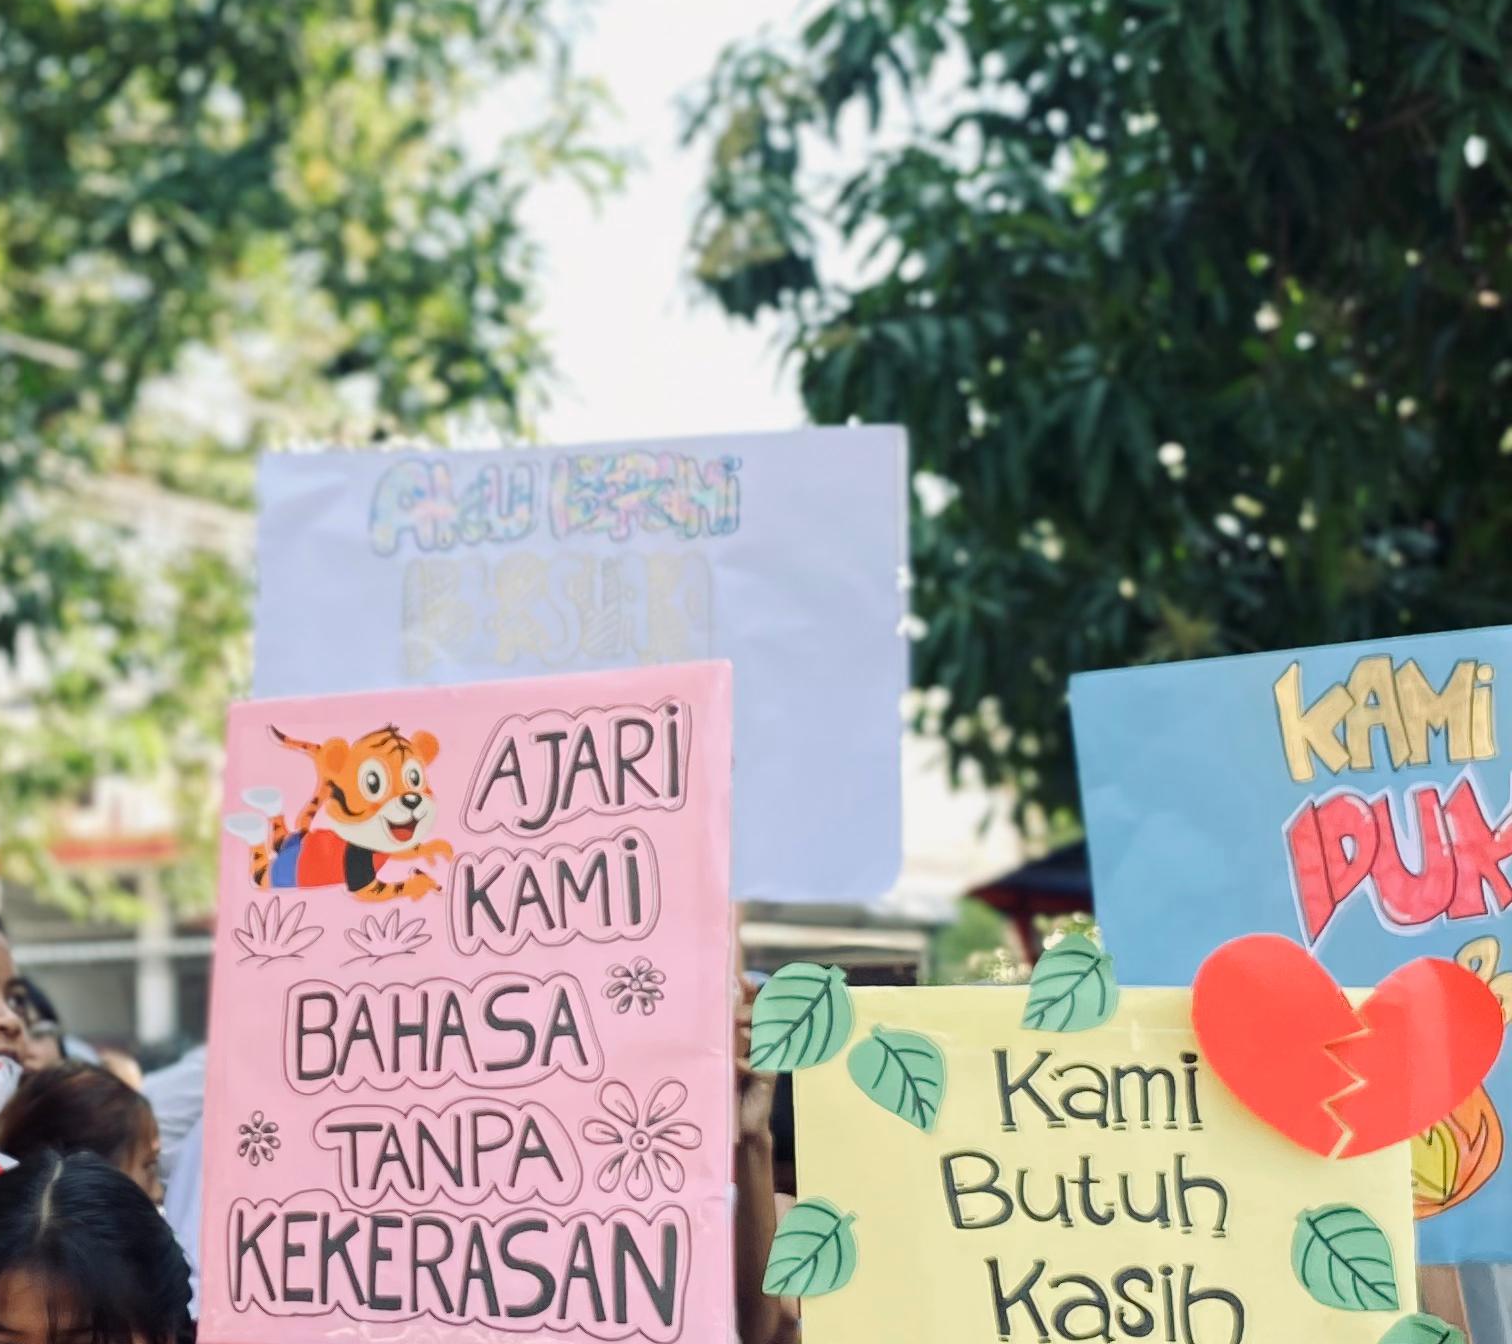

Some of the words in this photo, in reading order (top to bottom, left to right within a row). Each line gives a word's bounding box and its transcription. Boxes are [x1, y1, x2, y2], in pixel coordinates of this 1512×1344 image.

[297, 985, 588, 1081] BAHASA
[995, 1049, 1204, 1132] Kami
[326, 1112, 563, 1191] TANPA
[941, 1150, 1228, 1236] Butuh
[236, 1210, 677, 1327] KEKERASAN
